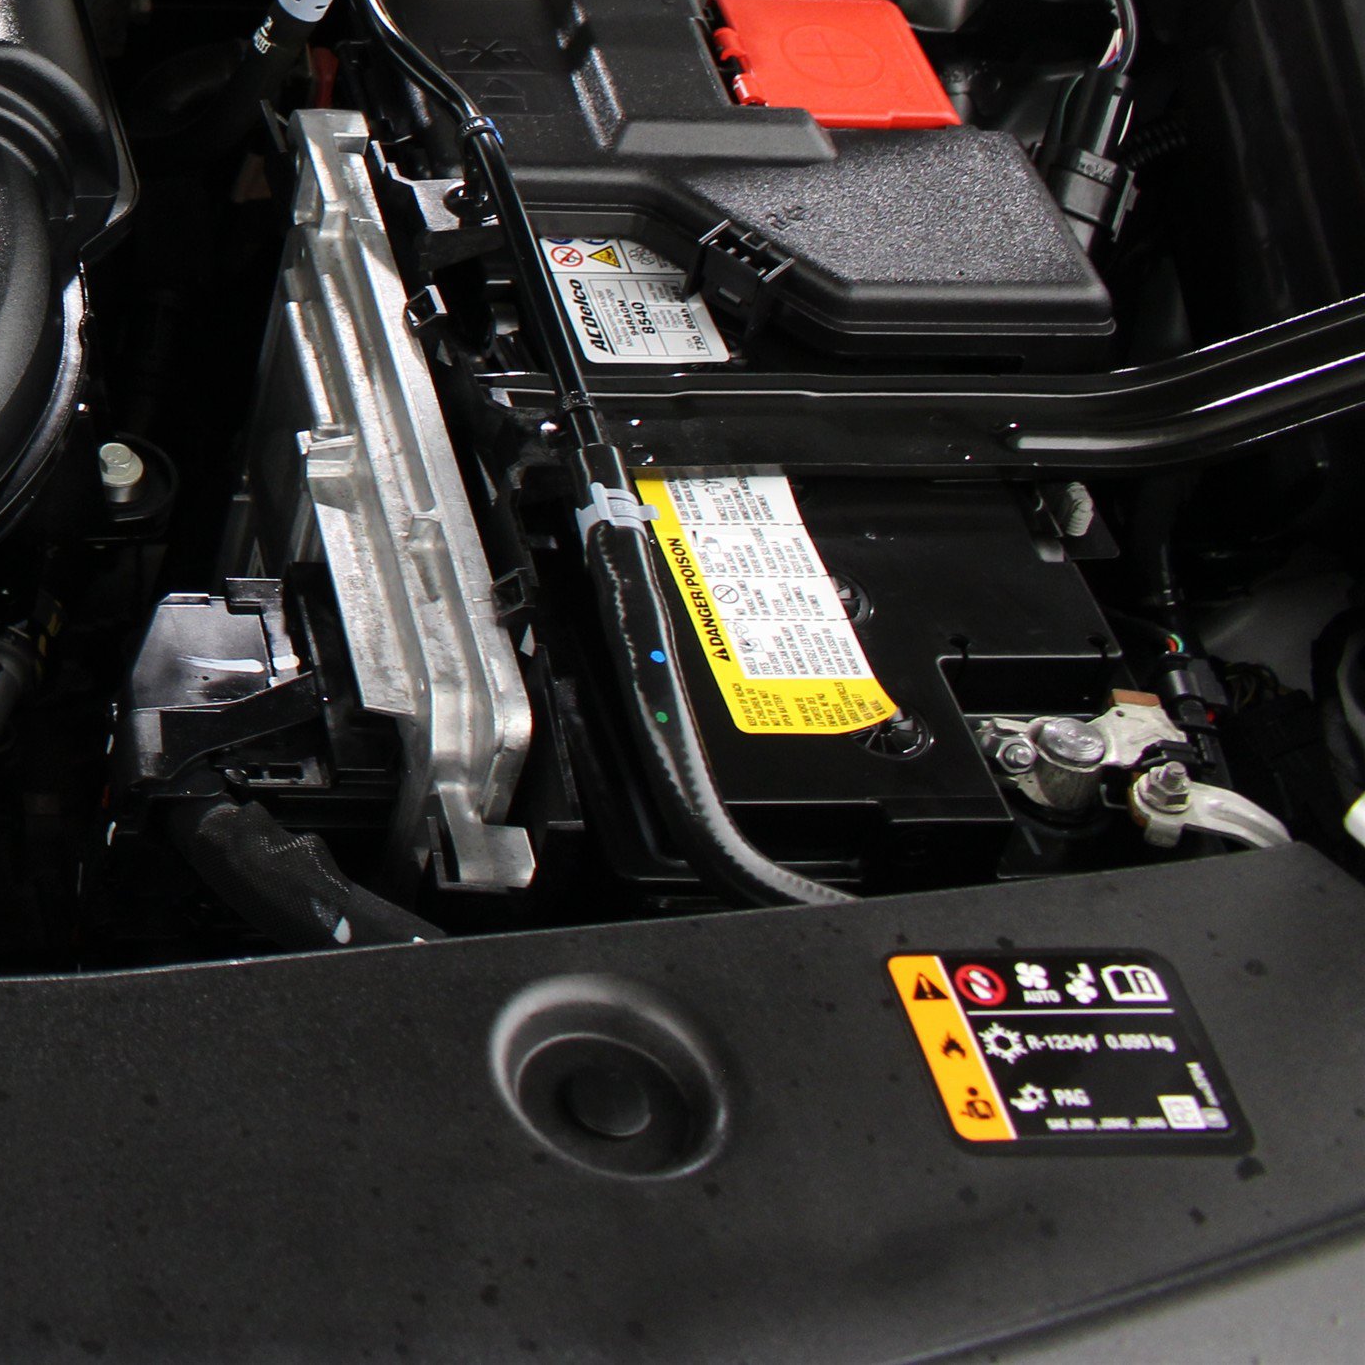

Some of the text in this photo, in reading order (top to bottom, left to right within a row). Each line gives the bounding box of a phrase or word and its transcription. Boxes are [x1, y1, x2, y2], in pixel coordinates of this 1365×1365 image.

[569, 279, 607, 351] ACDelco
[617, 299, 638, 335] 94RAGM
[631, 301, 655, 334] 8540
[680, 307, 695, 329] 80Ah
[691, 335, 705, 350] 730
[669, 538, 722, 646] DANGER/POISON
[1023, 989, 1060, 1002] AUTO
[1026, 1034, 1096, 1051] R-1234yf
[1149, 1034, 1174, 1051] kg
[1053, 1088, 1089, 1105] PAG
